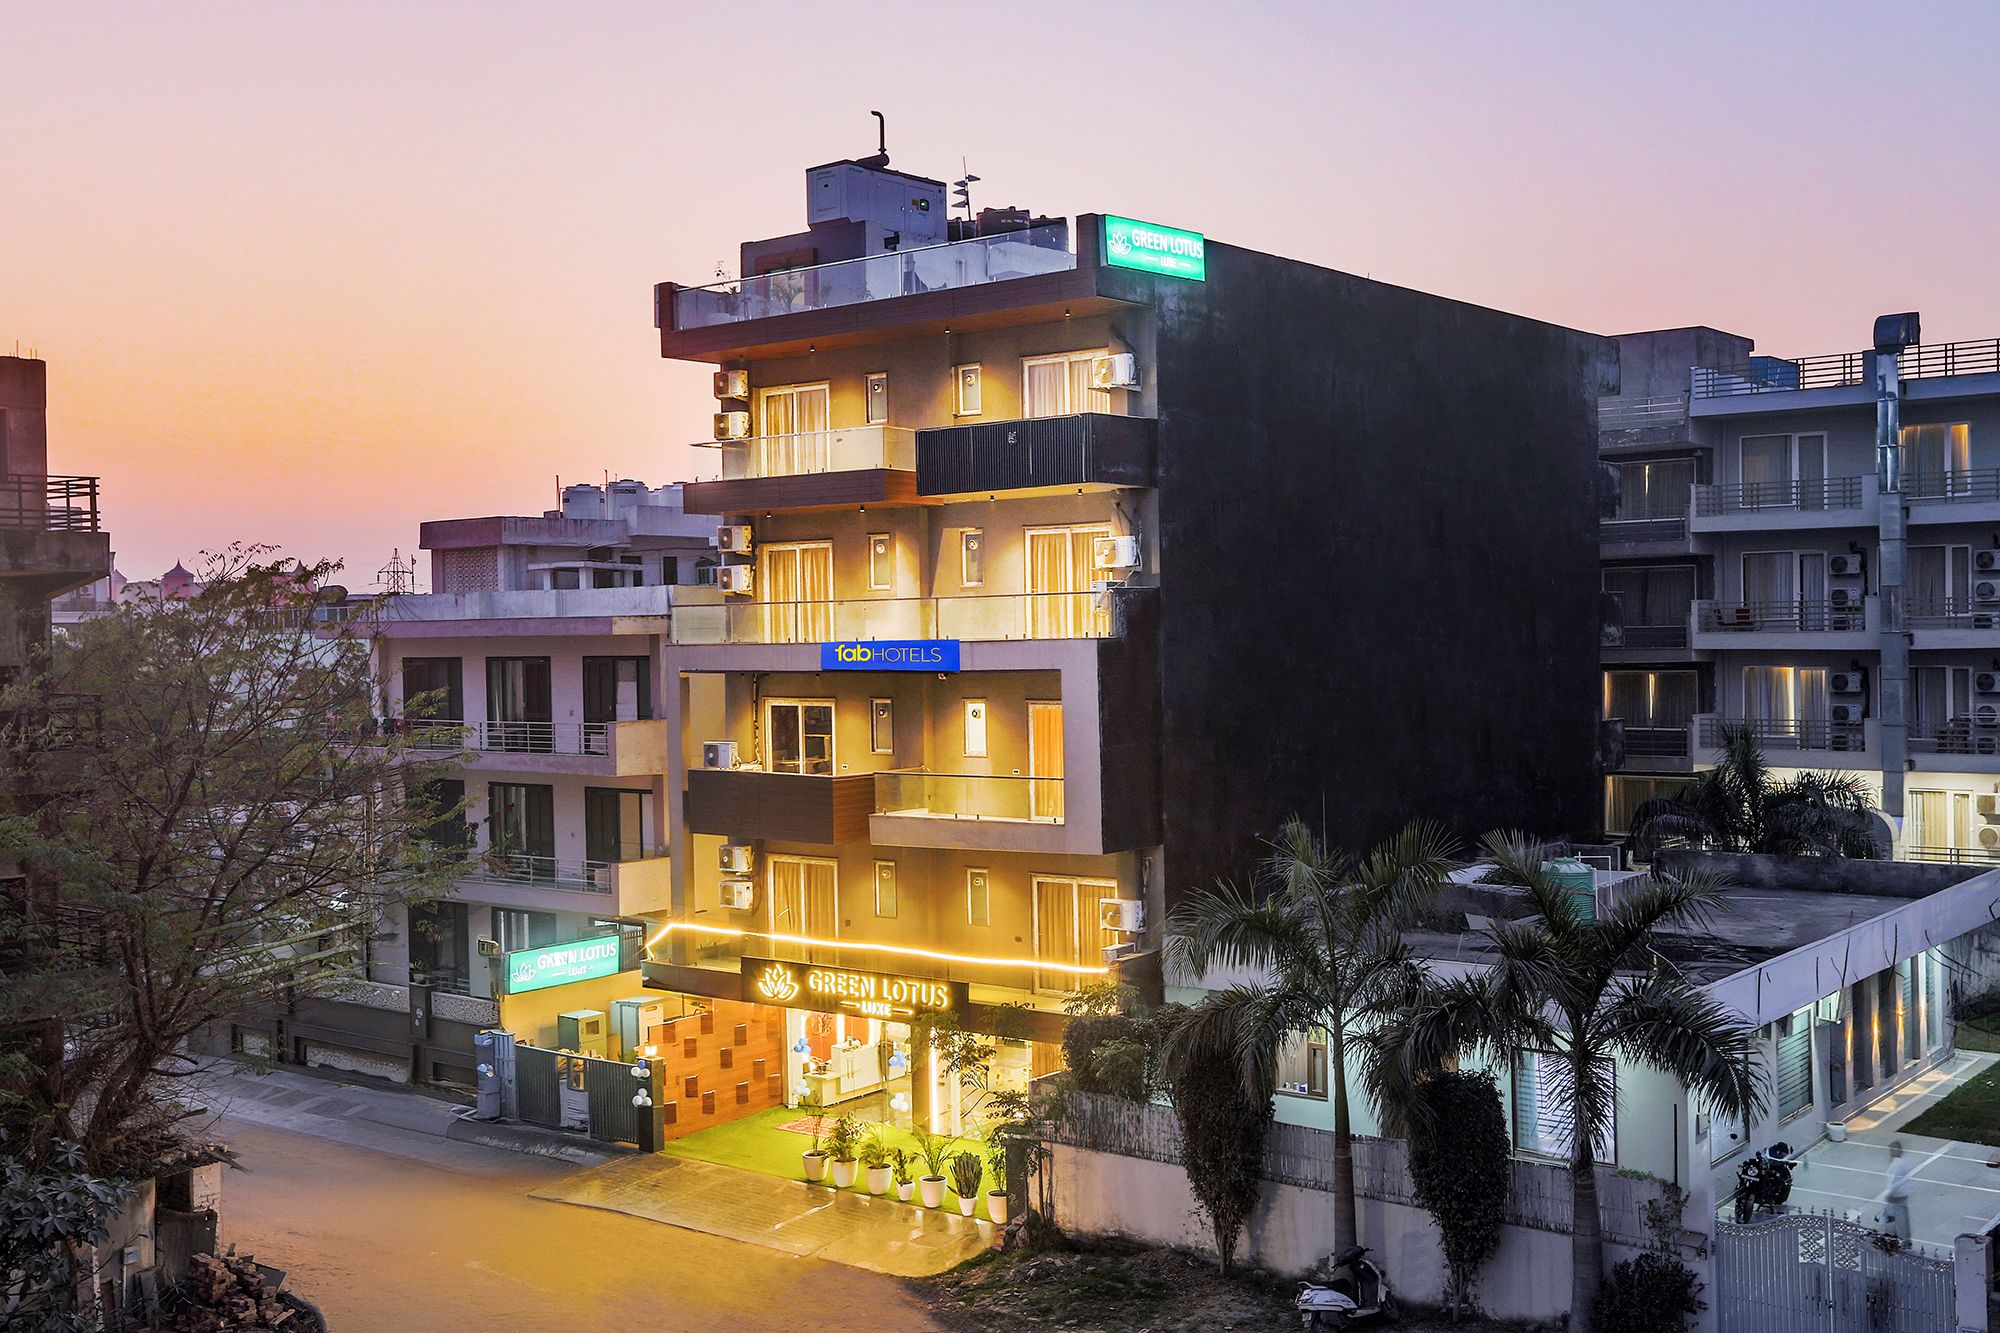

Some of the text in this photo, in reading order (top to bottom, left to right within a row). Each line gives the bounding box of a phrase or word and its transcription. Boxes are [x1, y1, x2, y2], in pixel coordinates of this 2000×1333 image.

[1132, 229, 1203, 258] GREEN LOTUS
[835, 644, 941, 662] fabHOTELS
[580, 942, 616, 962] LOTUS
[809, 970, 948, 1008] GREEN LOTUS
[861, 1001, 892, 1016] LUXE
